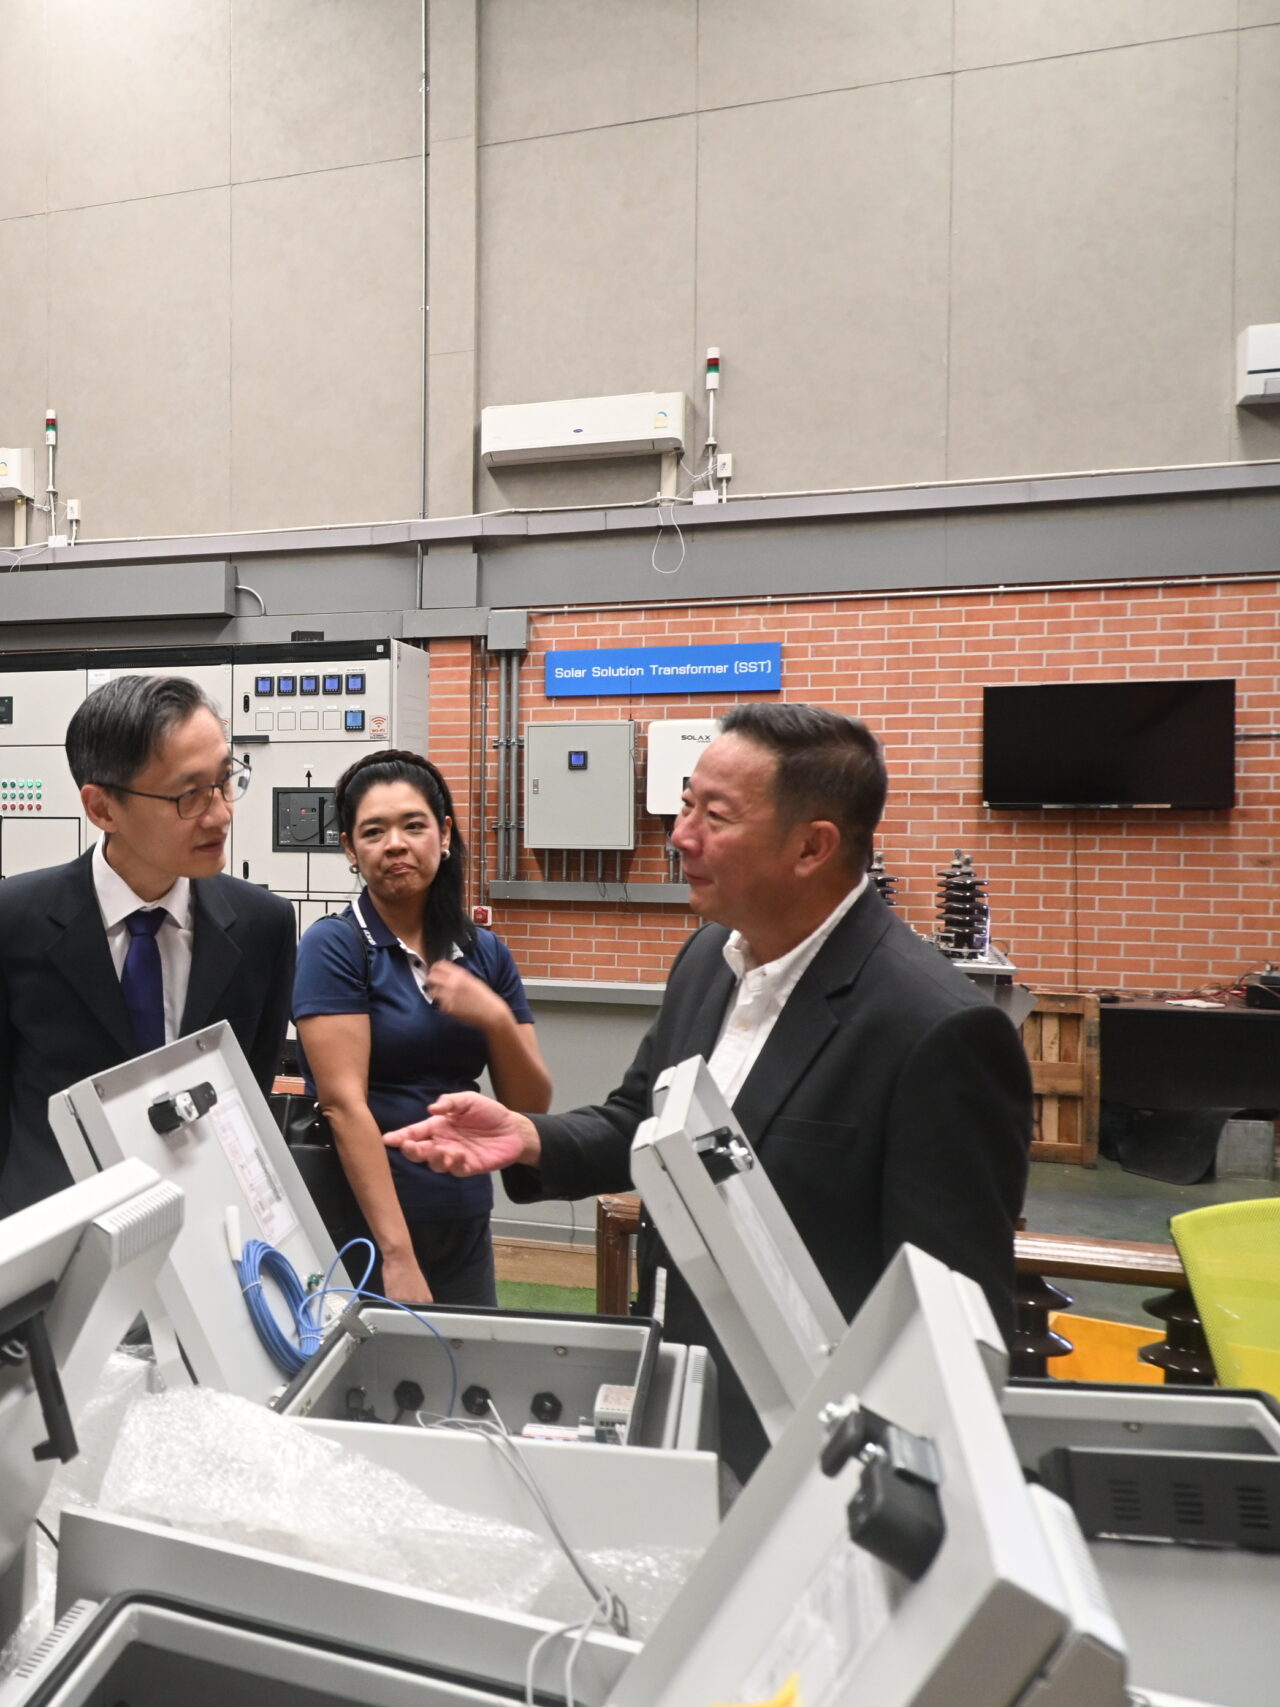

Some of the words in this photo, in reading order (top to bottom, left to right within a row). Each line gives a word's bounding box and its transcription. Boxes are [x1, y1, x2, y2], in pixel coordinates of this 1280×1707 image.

[555, 667, 587, 679] Solar
[591, 665, 644, 678] Solution
[649, 663, 729, 676] Transformer
[734, 660, 772, 675] (SST)
